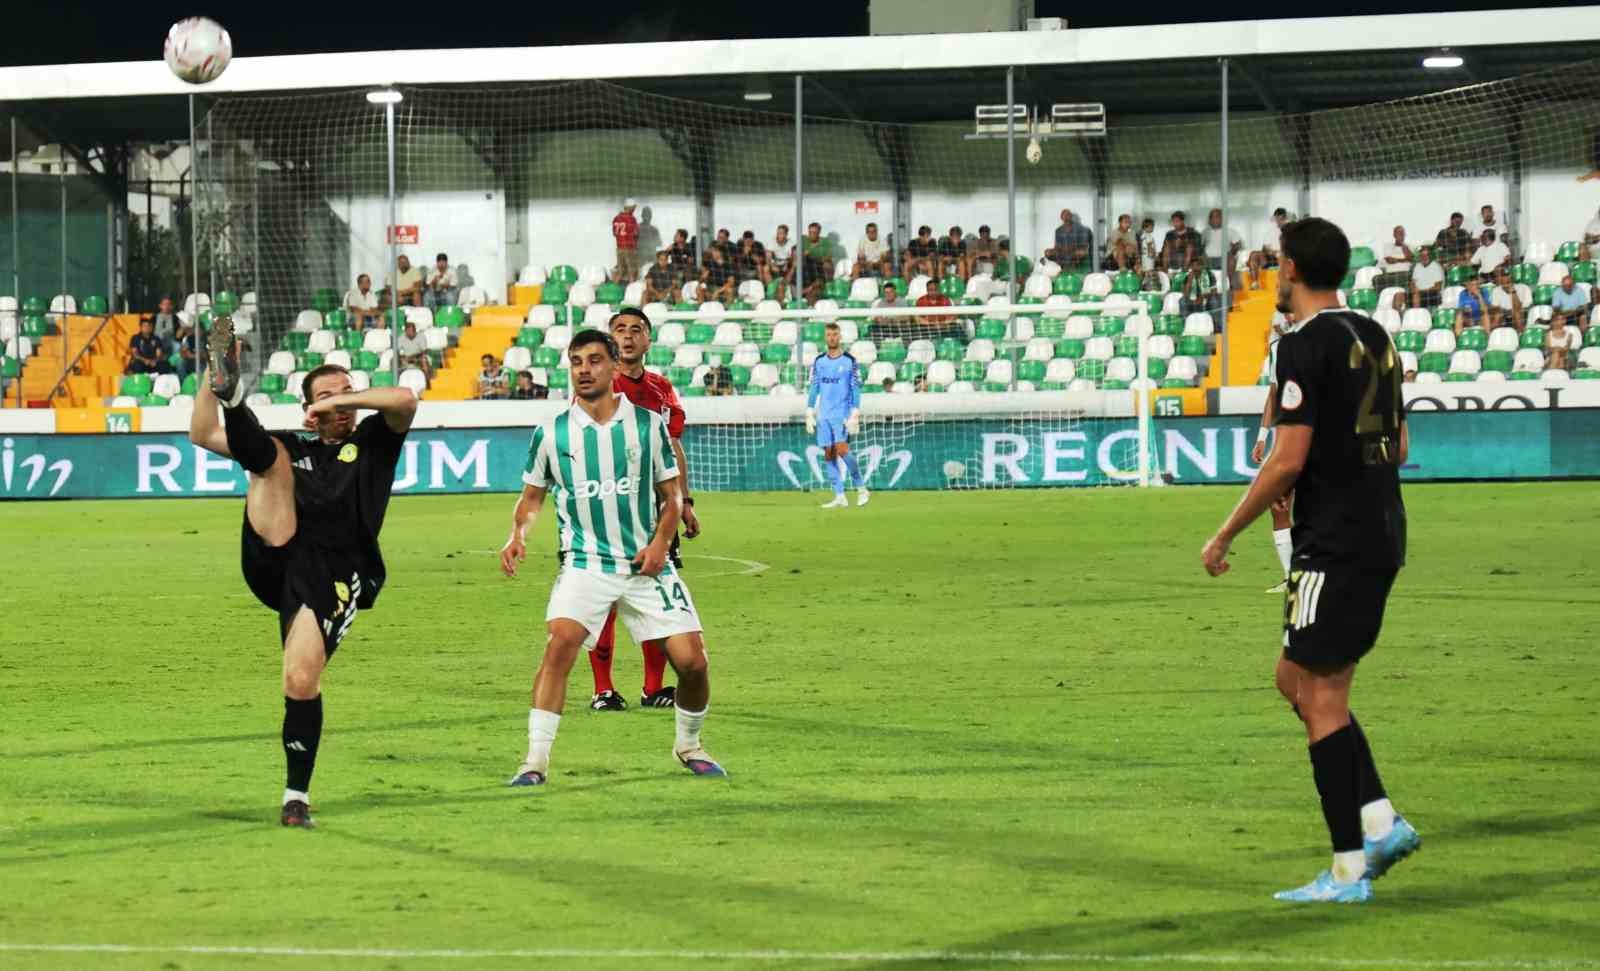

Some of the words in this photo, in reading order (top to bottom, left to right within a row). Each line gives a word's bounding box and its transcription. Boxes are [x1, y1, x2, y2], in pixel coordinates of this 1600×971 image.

[1157, 399, 1181, 416] 15
[107, 416, 129, 432] 14
[135, 439, 491, 492] REUM
[655, 582, 689, 611] 14
